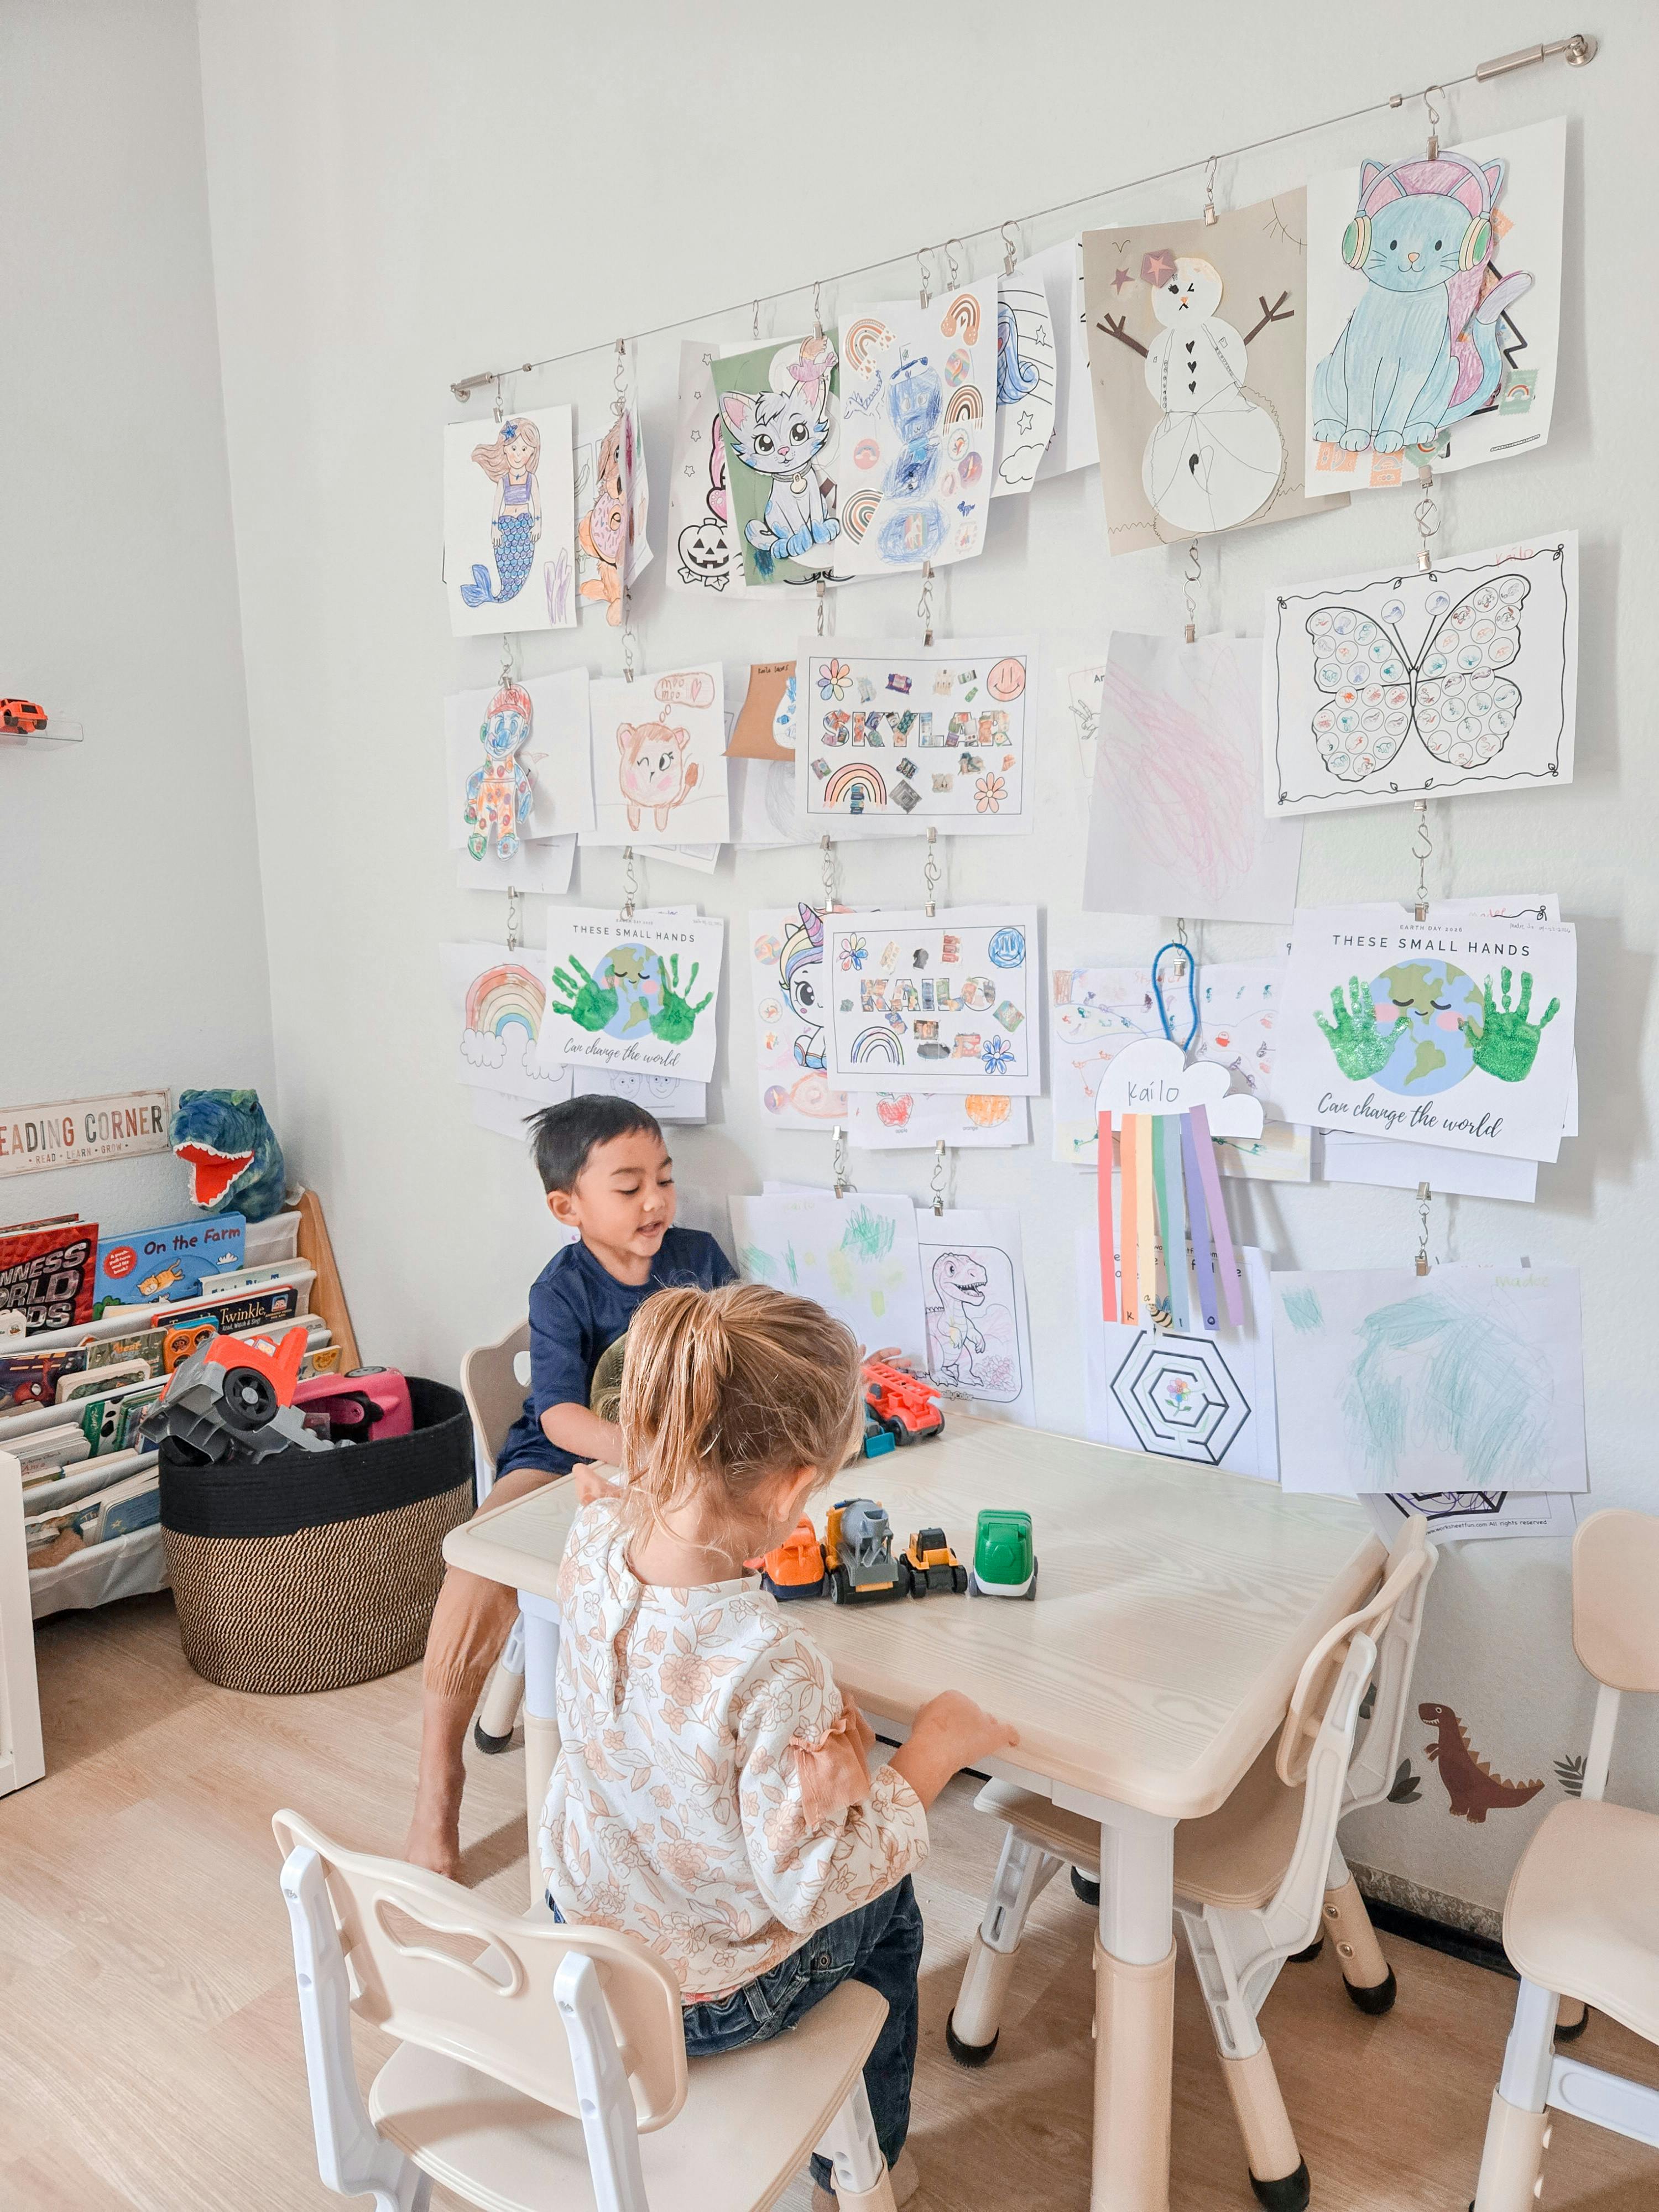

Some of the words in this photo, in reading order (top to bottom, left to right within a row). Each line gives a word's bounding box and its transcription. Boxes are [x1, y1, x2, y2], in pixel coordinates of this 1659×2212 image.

[821, 710, 1012, 748] SKYLAR
[573, 925, 609, 935] THESE
[616, 928, 651, 938] SMALL
[656, 932, 695, 942] HANDS
[1333, 935, 1388, 948] THESE
[1399, 938, 1458, 952] SMALL
[1469, 942, 1530, 956] HANDS
[860, 977, 996, 1011] KAILO
[564, 1037, 583, 1053] Can
[585, 1037, 621, 1063] change
[622, 1042, 641, 1061] the
[643, 1050, 681, 1067] world
[85, 1105, 164, 1144] CORNER
[1318, 1092, 1349, 1114] Can
[1353, 1093, 1407, 1130] change
[1410, 1100, 1439, 1128] the
[1443, 1113, 1504, 1138] world
[35, 1152, 56, 1164] READ
[66, 1148, 92, 1160] LEARN
[101, 1144, 122, 1154] GROW
[144, 1241, 166, 1255] On
[172, 1234, 198, 1251] the
[204, 1228, 241, 1243] Farm
[220, 1302, 267, 1325] Twinkle,
